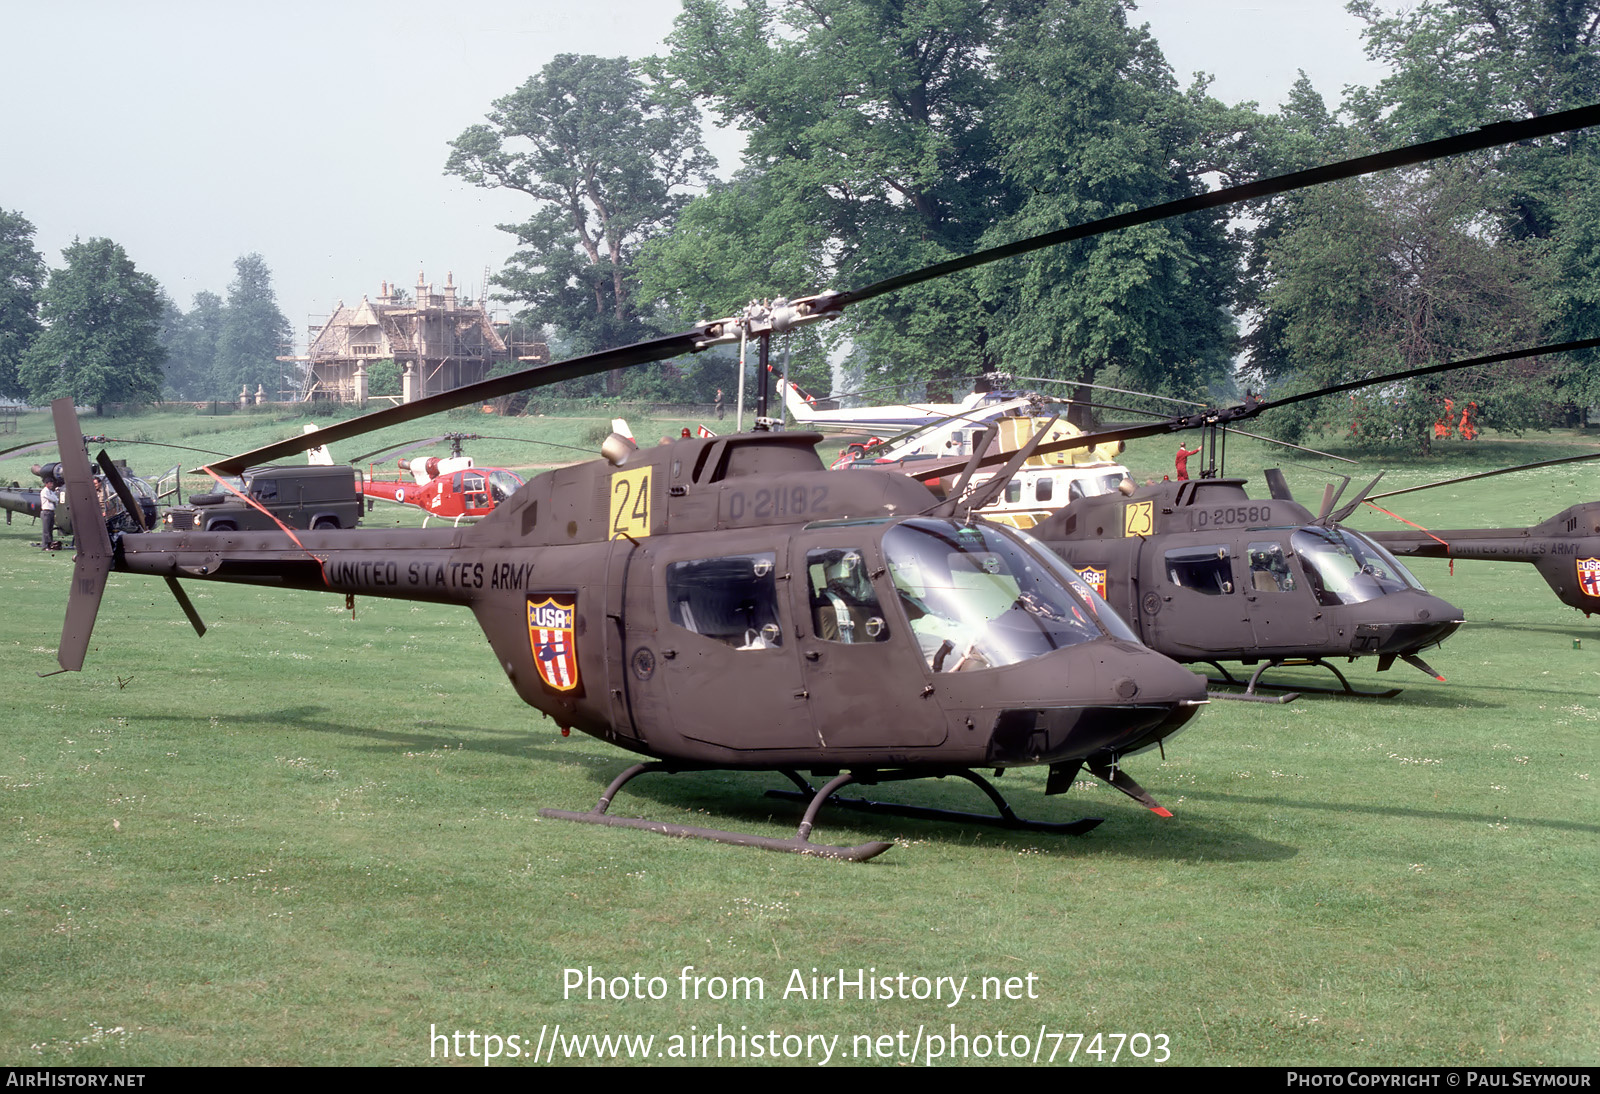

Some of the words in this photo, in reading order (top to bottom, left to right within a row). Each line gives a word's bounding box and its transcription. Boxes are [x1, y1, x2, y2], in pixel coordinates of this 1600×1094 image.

[613, 476, 648, 533] 24
[1127, 502, 1152, 533] 23
[1455, 544, 1498, 554] UNITED
[1502, 543, 1547, 555] STATES
[1550, 543, 1581, 555] ARMY
[330, 561, 398, 586] UNITED
[408, 561, 483, 588] STATES
[491, 562, 535, 590] ARMY
[535, 607, 566, 629] USA
